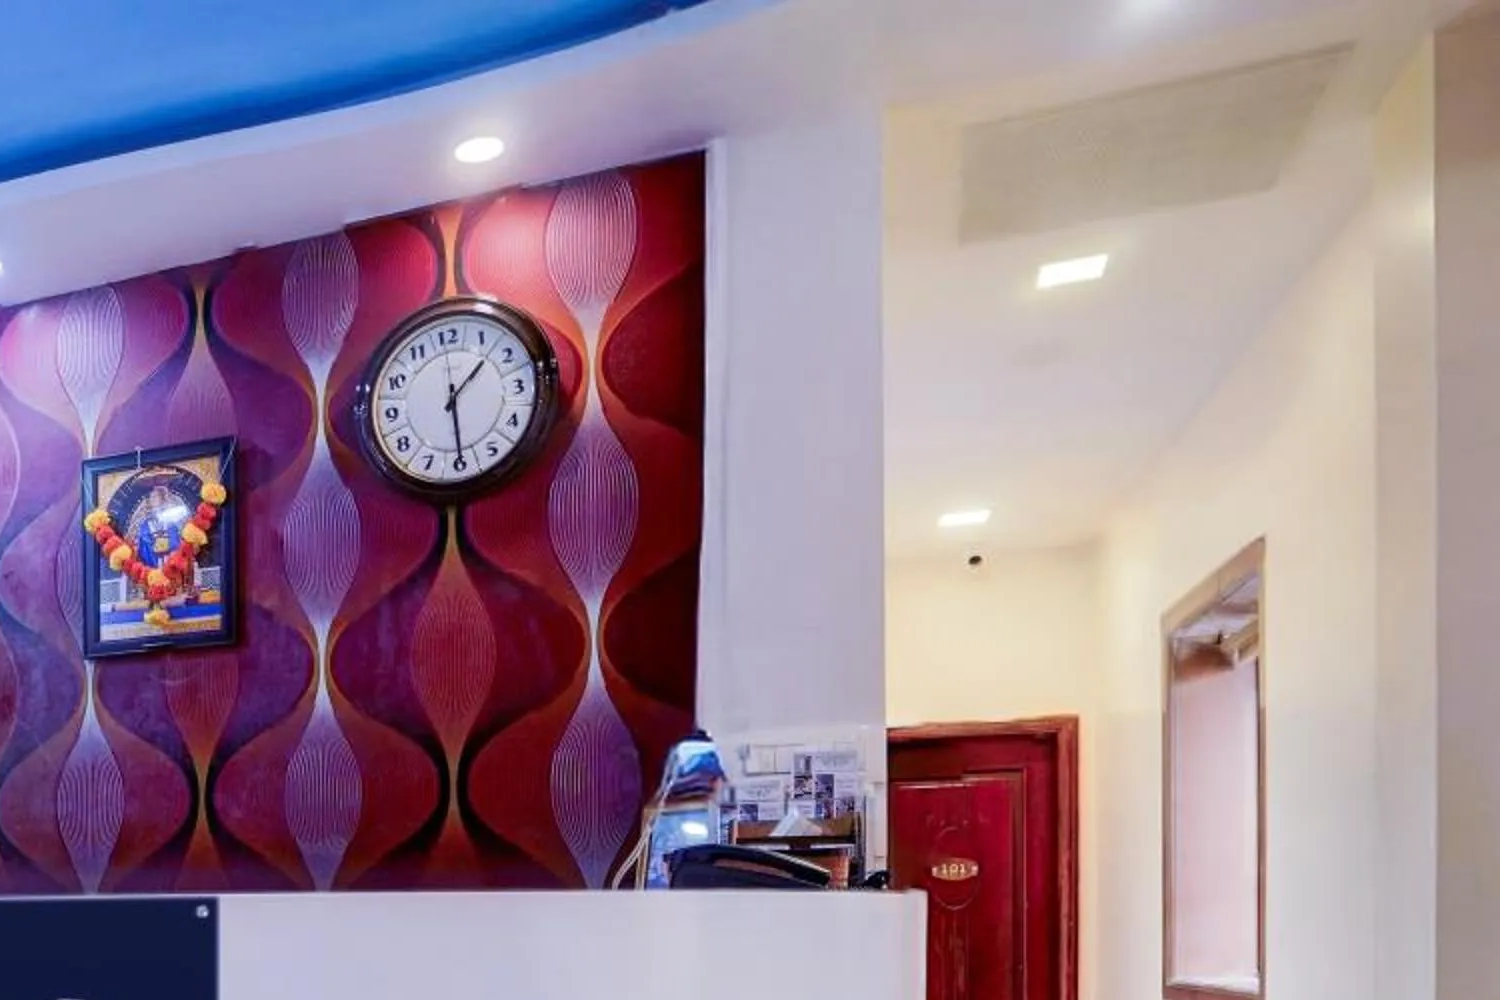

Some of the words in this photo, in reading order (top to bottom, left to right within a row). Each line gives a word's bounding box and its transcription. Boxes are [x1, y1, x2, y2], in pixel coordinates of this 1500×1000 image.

[438, 328, 458, 345] 12
[477, 331, 485, 346] 1
[409, 345, 425, 361] 11
[502, 348, 513, 363] 2
[388, 374, 406, 391] 10
[513, 379, 525, 395] 3
[385, 407, 398, 422] 9
[506, 412, 518, 428] 4
[396, 437, 410, 452] 8
[486, 441, 498, 457] 5
[422, 455, 434, 471] 7
[453, 456, 467, 472] 6
